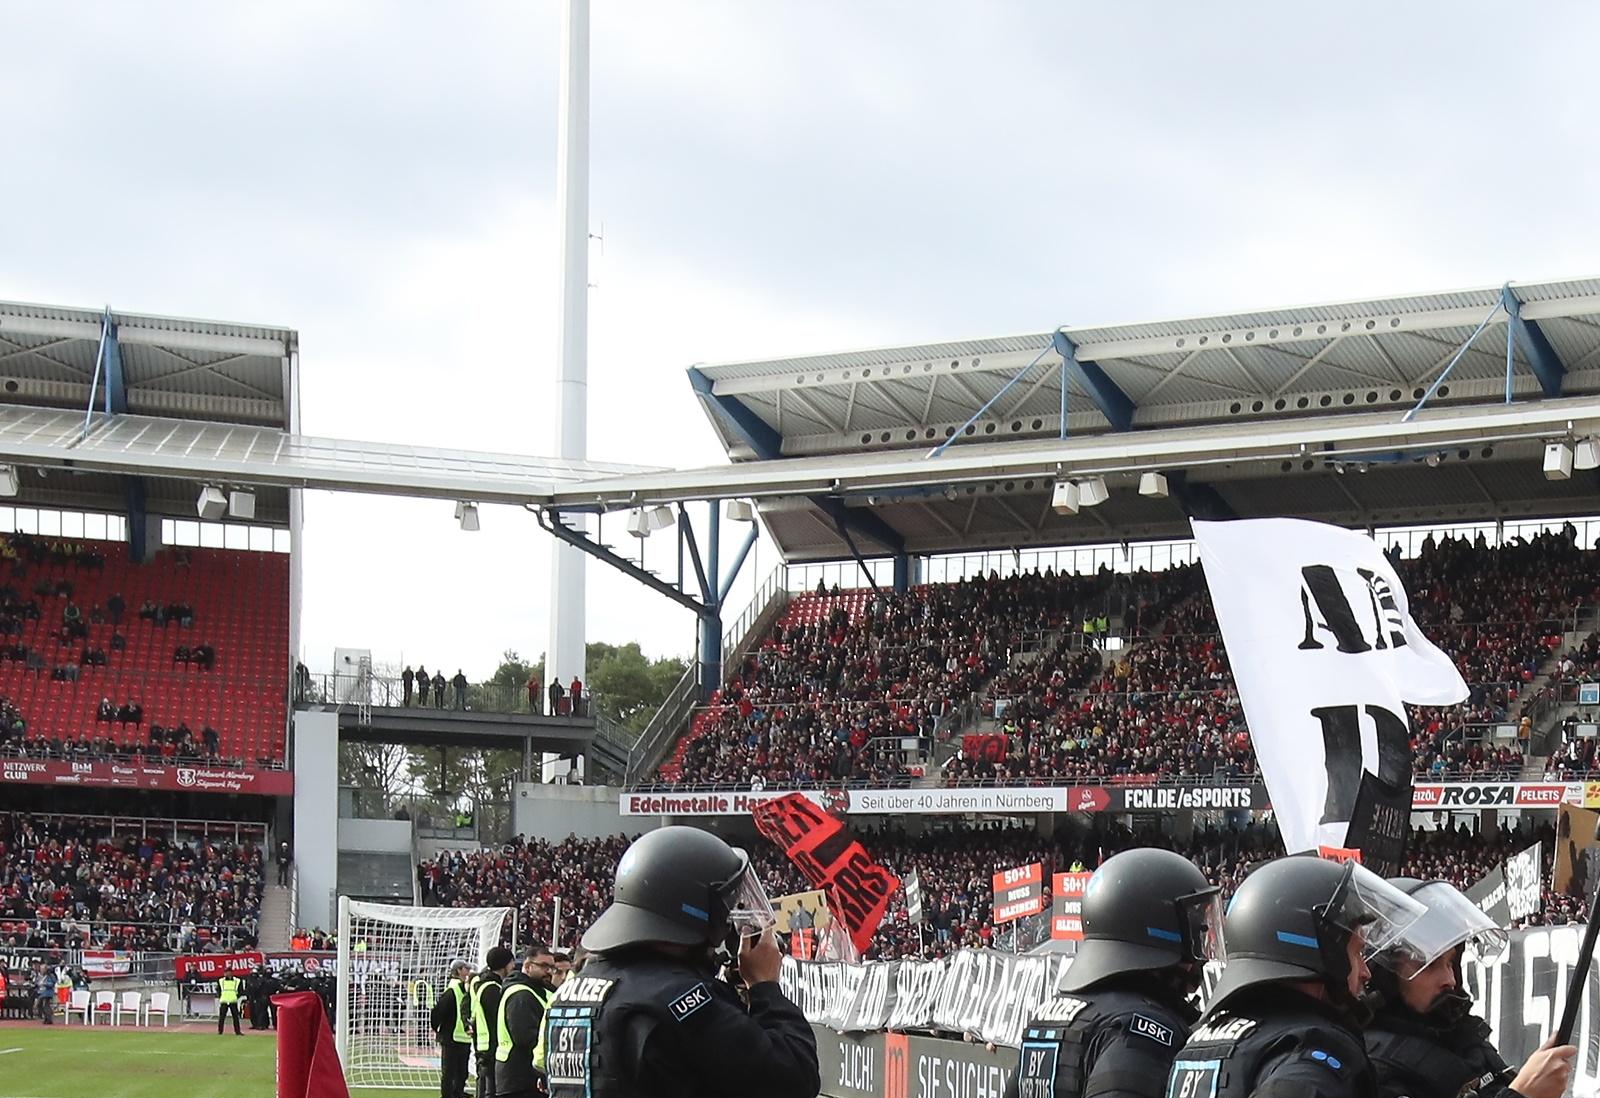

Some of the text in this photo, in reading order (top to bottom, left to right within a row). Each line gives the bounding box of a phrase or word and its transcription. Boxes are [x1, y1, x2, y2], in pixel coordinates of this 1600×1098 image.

[3, 762, 47, 772] NETZWERK
[3, 771, 28, 780] CLUB
[629, 795, 729, 813] Edelmetalle
[861, 792, 1054, 811] Seit über 40 Jahren in Nürnberg
[1124, 787, 1251, 810] FCN.DE/eSPORTS
[1441, 786, 1515, 806] ROSA
[1520, 789, 1561, 801] PELLETS
[1003, 865, 1031, 884] 50+1
[1062, 876, 1087, 893] 50+1
[1064, 901, 1082, 914] MUS
[225, 957, 256, 971] FANS
[555, 977, 614, 1002] POLIZEI
[675, 987, 706, 1015] USK
[559, 1026, 577, 1052] BY
[1137, 1018, 1168, 1042] USK
[1028, 1051, 1046, 1077] BY
[1180, 1070, 1204, 1098] BY
